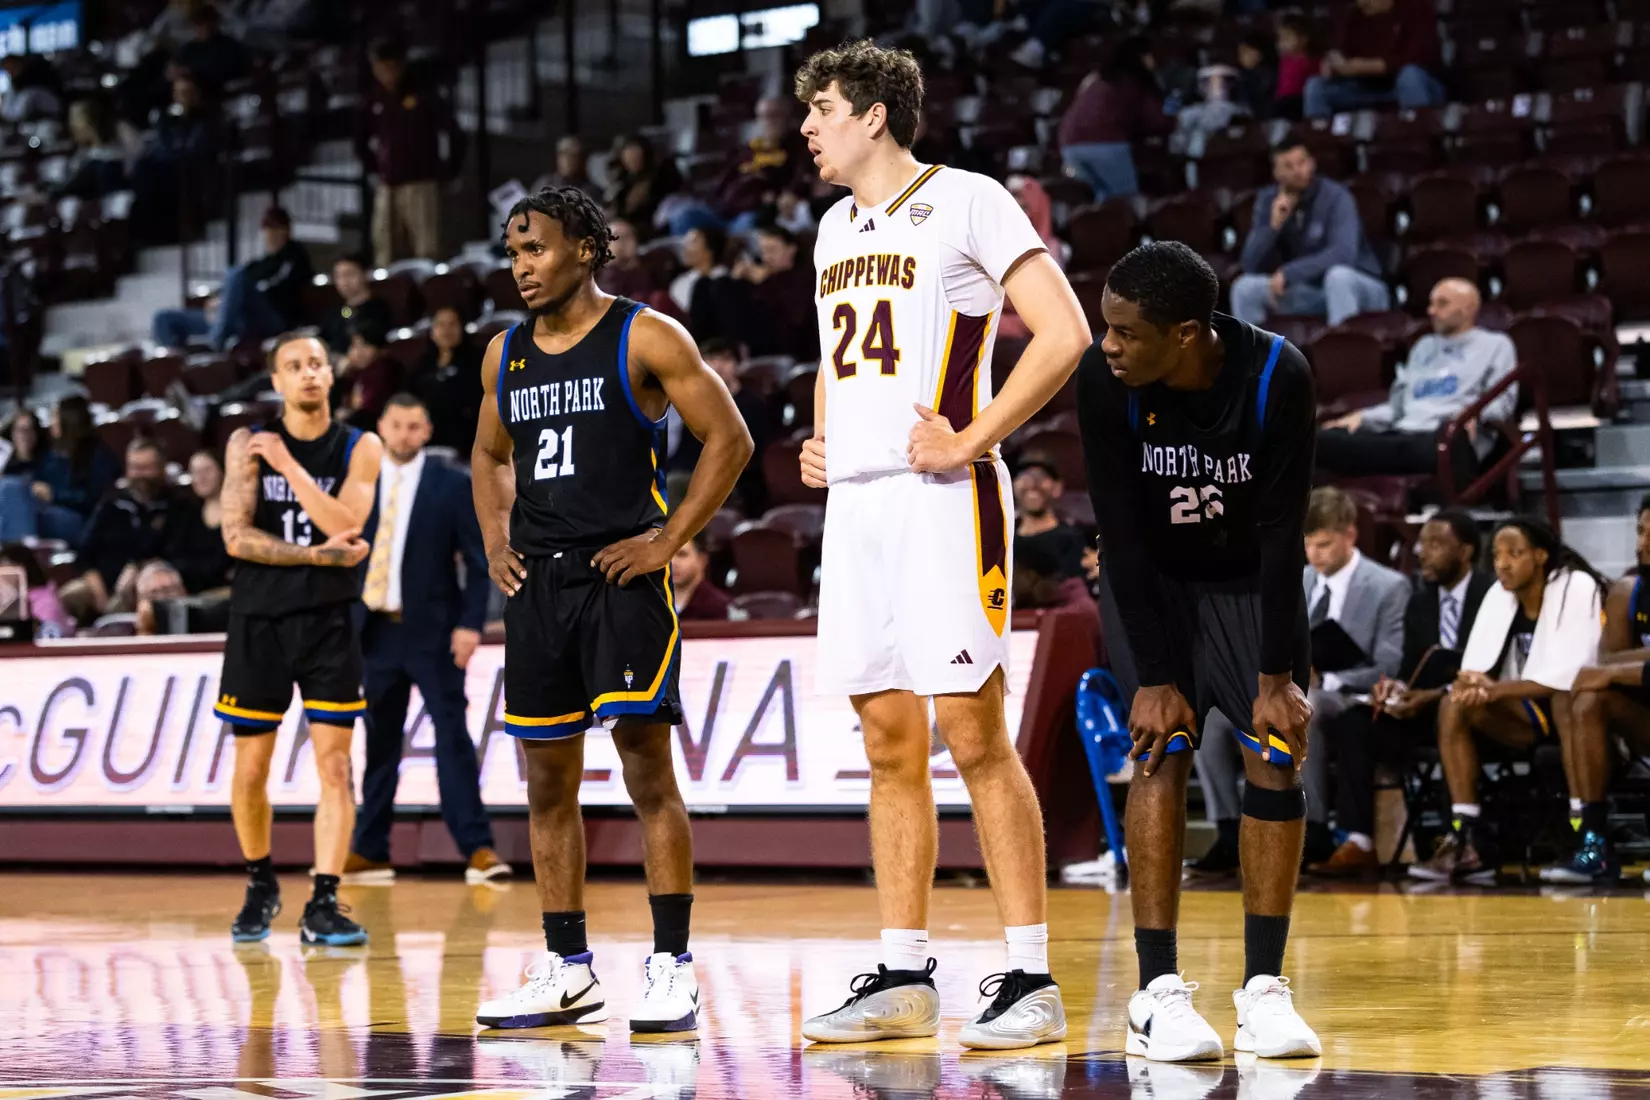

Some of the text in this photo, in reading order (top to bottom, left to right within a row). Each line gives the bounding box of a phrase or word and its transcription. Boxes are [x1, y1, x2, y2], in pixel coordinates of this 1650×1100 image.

[820, 254, 917, 299] CHIPPEWAS
[832, 299, 900, 380] 24
[510, 377, 605, 422] NORTH PARK
[534, 425, 575, 480] 21
[1142, 441, 1253, 484] NORTH PARK
[281, 508, 312, 547] 13
